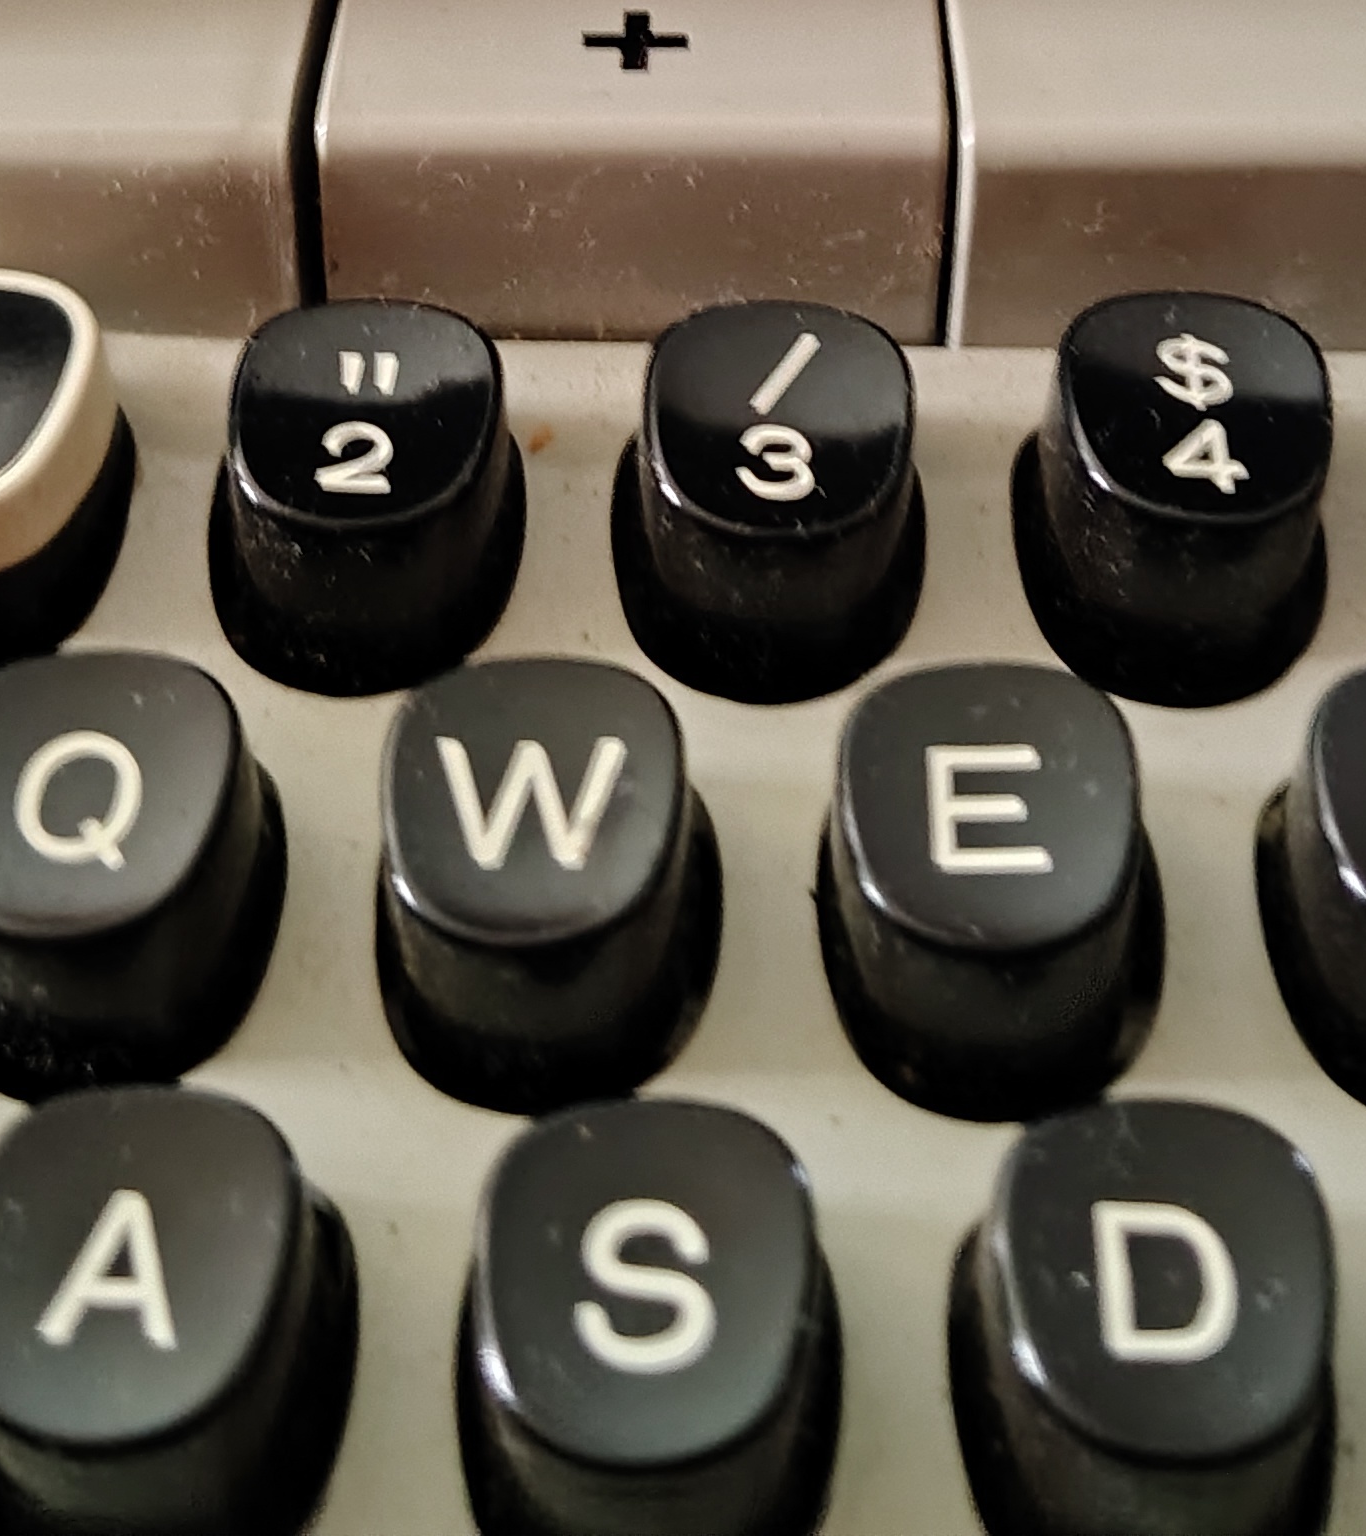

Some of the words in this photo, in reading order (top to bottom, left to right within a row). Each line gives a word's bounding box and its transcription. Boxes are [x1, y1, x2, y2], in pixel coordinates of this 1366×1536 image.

[748, 331, 823, 416] /
[1153, 332, 1235, 412] $
[313, 419, 395, 496] 2
[735, 422, 816, 502] 3
[1161, 417, 1251, 496] 4
[12, 730, 146, 874] Q
[435, 735, 629, 872] W
[925, 742, 1055, 876] E
[34, 1188, 179, 1352] A
[573, 1198, 717, 1376] S
[1091, 1199, 1240, 1363] D
